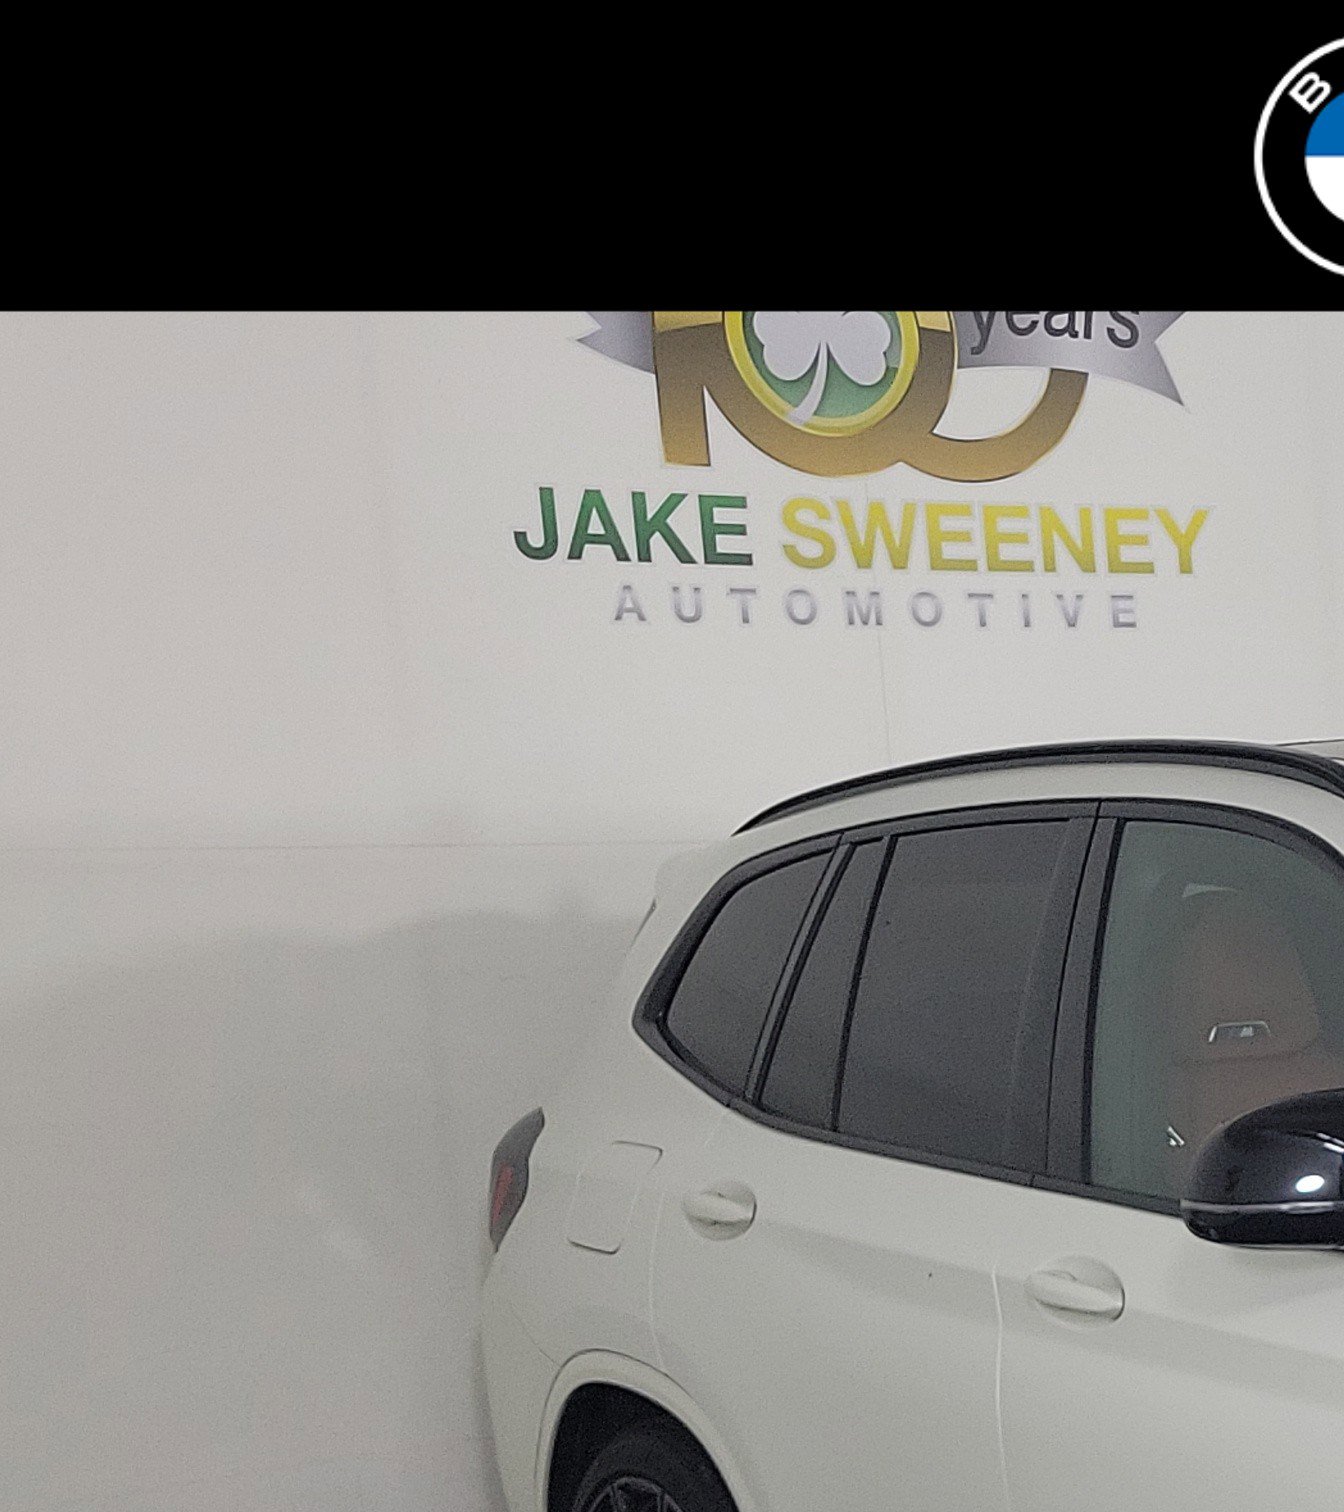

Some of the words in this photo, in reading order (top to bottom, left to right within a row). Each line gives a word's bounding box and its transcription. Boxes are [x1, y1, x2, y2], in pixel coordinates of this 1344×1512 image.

[513, 486, 754, 566] JAKE
[781, 496, 1211, 575] SWEENEY
[612, 584, 1138, 630] AUTOMOTIVE
